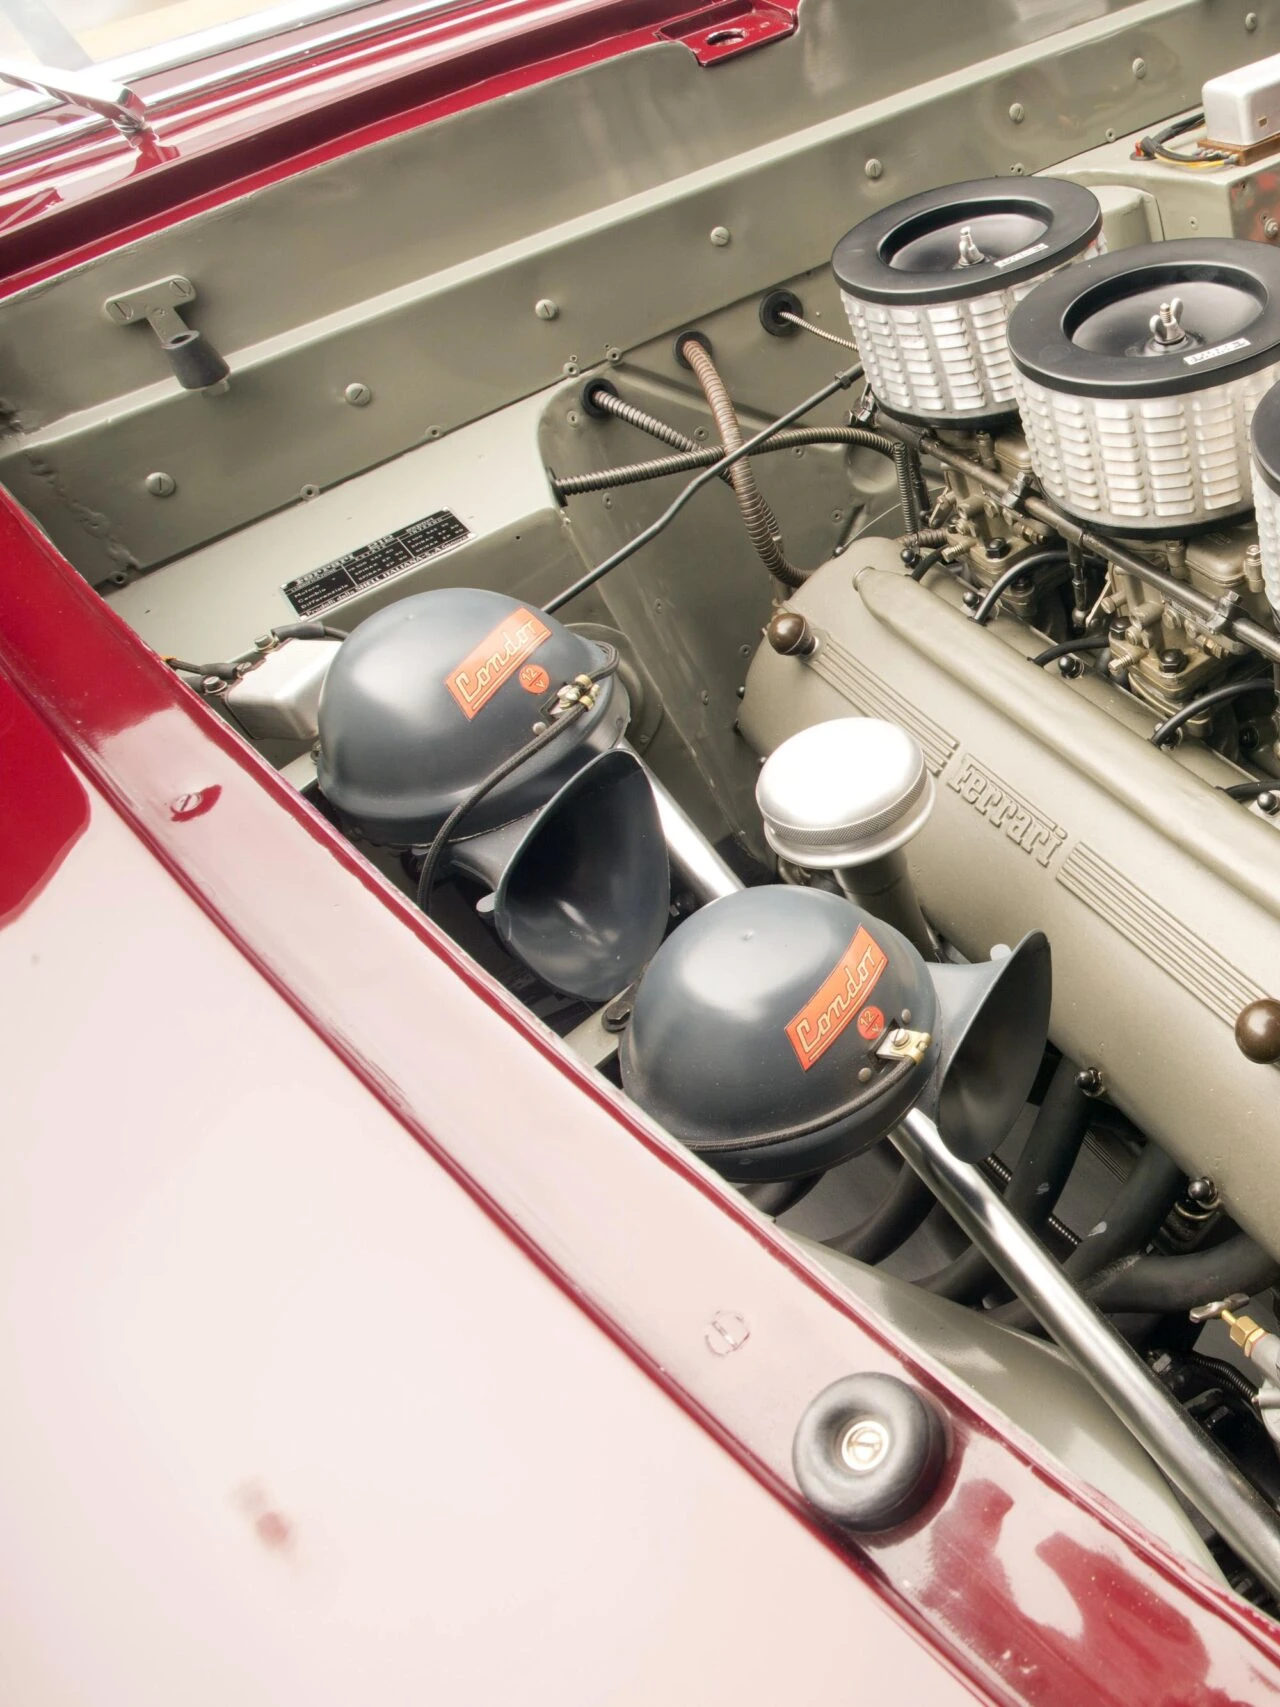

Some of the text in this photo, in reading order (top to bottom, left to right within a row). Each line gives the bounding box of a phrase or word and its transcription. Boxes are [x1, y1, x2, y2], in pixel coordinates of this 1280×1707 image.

[521, 667, 538, 682] 12
[946, 753, 1068, 868] Ferrari
[795, 943, 876, 1054] Condor
